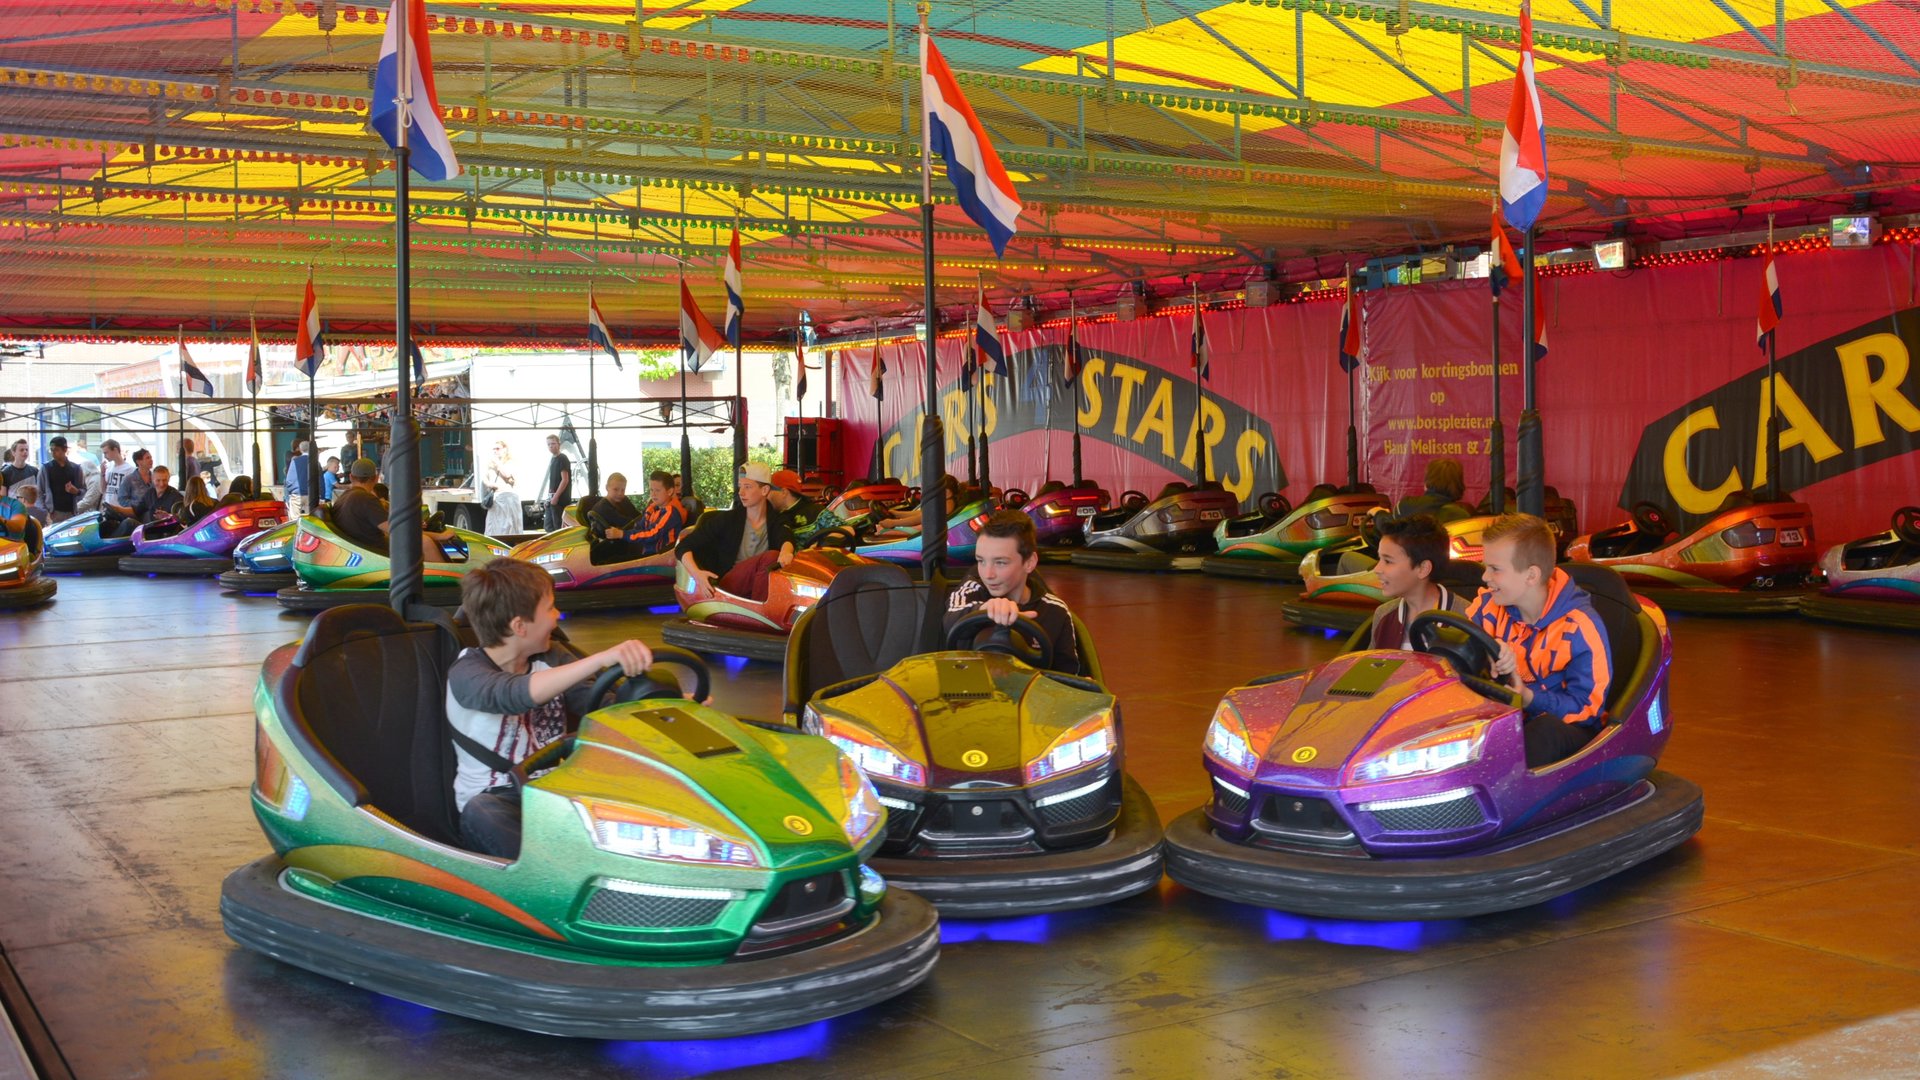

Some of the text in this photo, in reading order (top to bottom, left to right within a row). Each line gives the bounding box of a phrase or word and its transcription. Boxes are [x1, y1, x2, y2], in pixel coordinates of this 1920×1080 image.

[1369, 360, 1519, 384] Kijk voor kortingsbonen
[1430, 391, 1445, 406] op
[883, 371, 998, 487] CRS
[1076, 357, 1267, 504] STARS
[1388, 412, 1494, 432] www.botsplezier.n
[1663, 332, 1920, 514] CAR
[1411, 439, 1463, 455] Melissen
[1467, 440, 1479, 455] &
